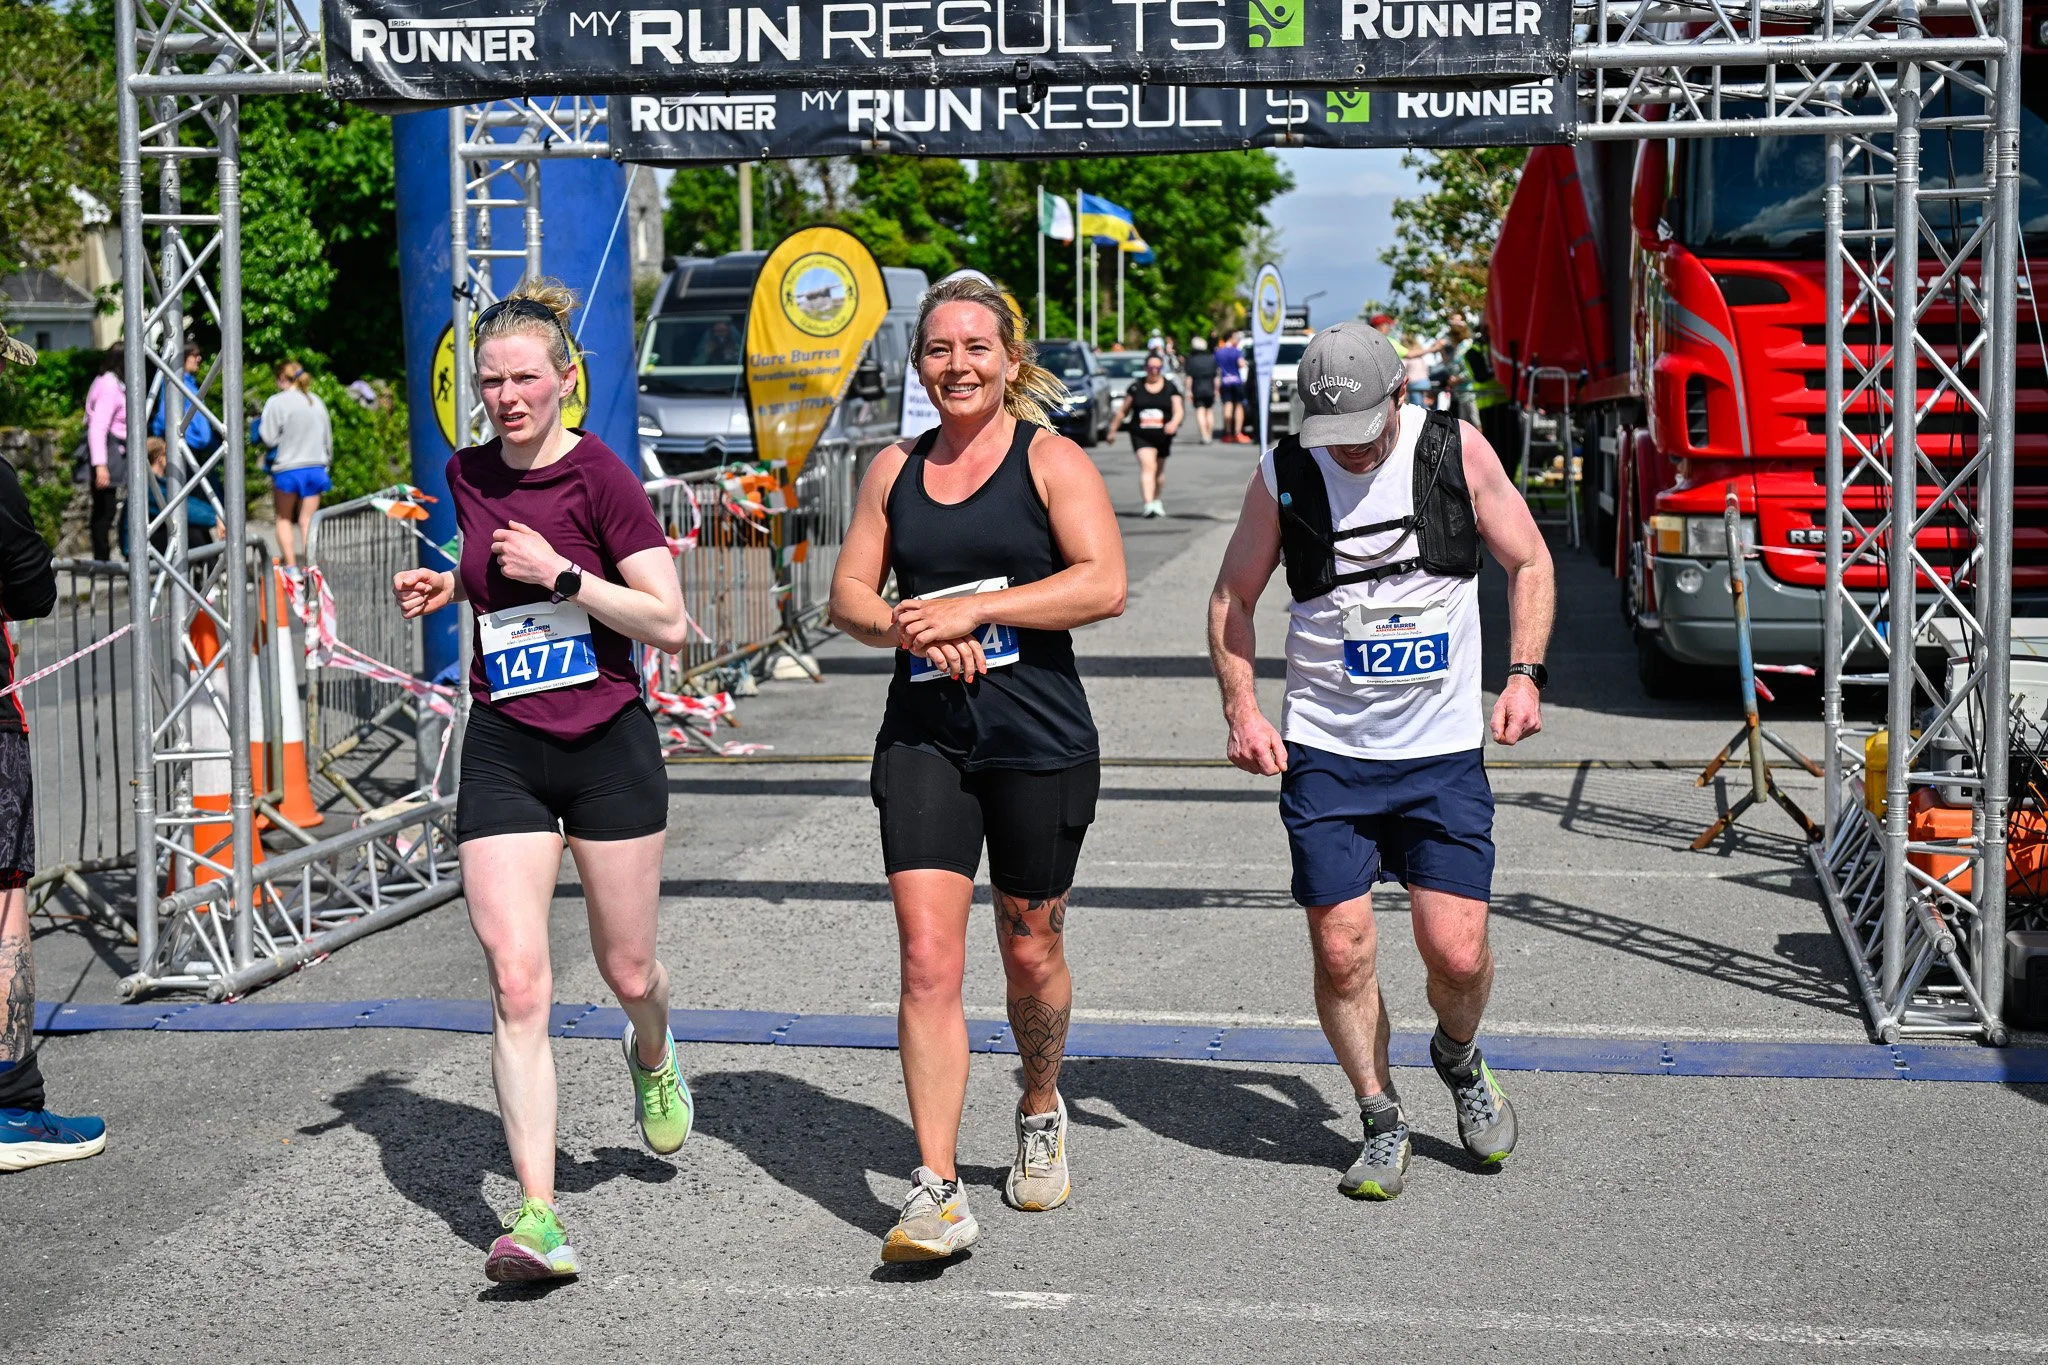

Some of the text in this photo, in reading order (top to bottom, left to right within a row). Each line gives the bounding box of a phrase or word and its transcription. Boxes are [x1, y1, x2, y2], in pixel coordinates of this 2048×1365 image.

[569, 0, 1227, 65] MY RUN RESULTS
[1341, 0, 1542, 41] RUNNER
[351, 18, 537, 63] RUNNER
[631, 96, 777, 132] RUNNER
[801, 90, 842, 112] MY
[847, 88, 982, 133] RUN
[1397, 88, 1554, 119] RUNNER
[791, 348, 840, 363] Burren
[1309, 374, 1362, 396] Callaway
[1363, 411, 1383, 437] CHROME
[1371, 418, 1383, 436] SOFT
[495, 639, 575, 686] 1477
[1356, 639, 1436, 673] 1276
